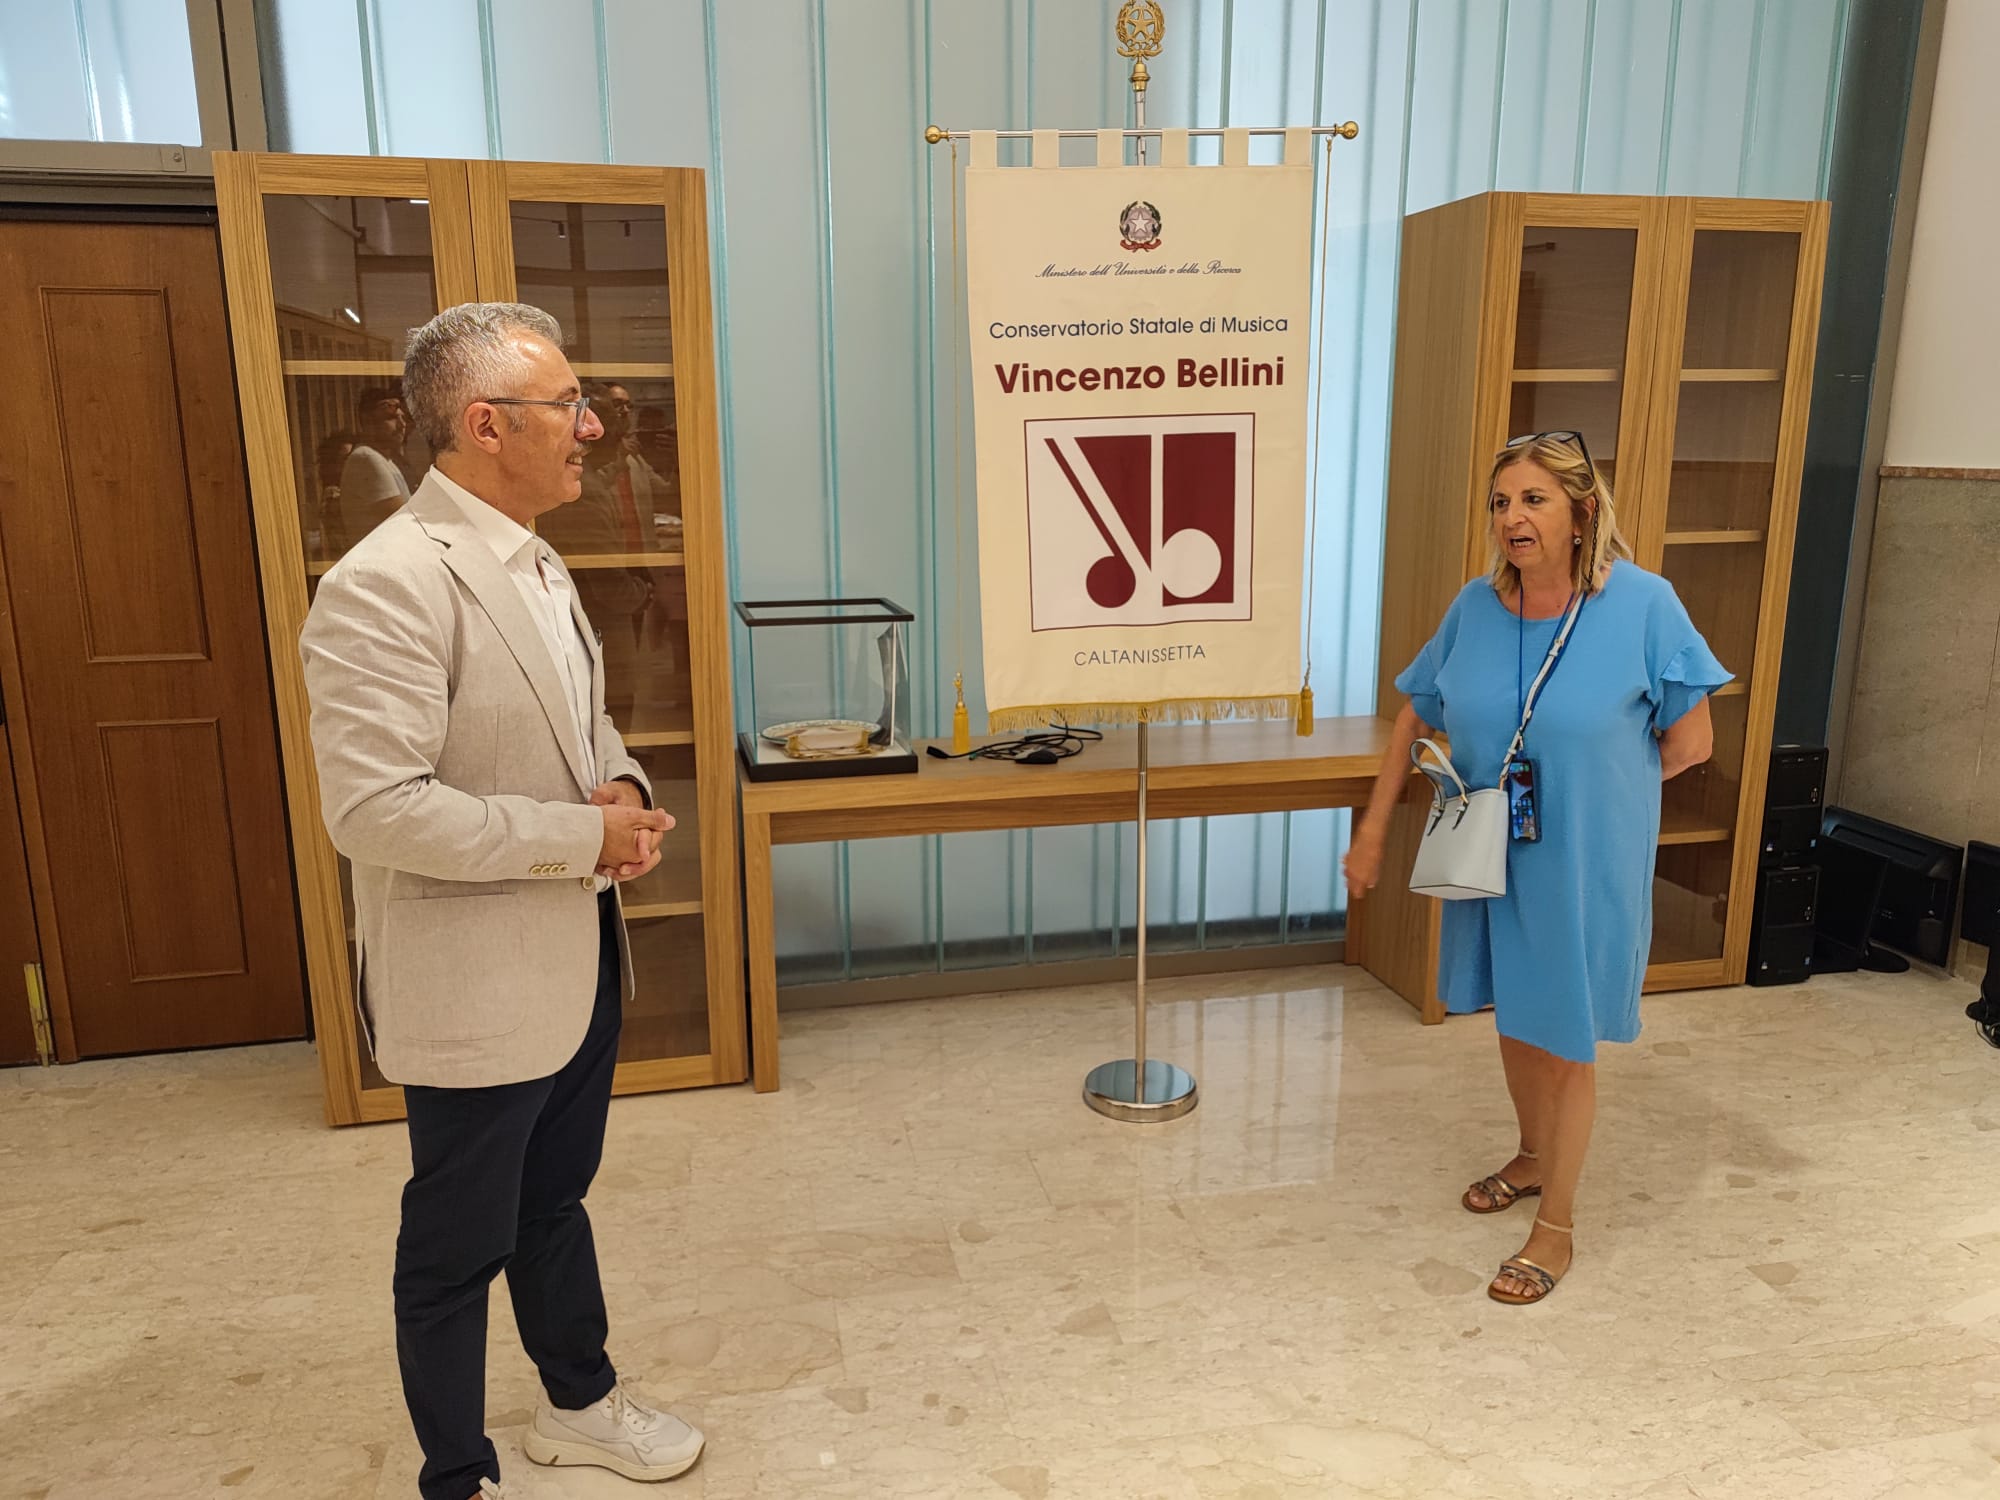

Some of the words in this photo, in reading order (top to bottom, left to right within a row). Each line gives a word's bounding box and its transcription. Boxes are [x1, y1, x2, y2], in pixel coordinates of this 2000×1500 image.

[1034, 263, 1087, 278] Ministero
[1177, 263, 1200, 274] della
[1202, 259, 1242, 275] Ricerca
[989, 318, 1124, 340] Conservatorio
[1129, 316, 1194, 335] Statale
[1199, 316, 1216, 334] di
[1221, 315, 1288, 333] Musica
[994, 362, 1166, 394] Vincenzo
[1177, 356, 1284, 388] Bellini
[1074, 644, 1206, 666] CALTANISSETTA
